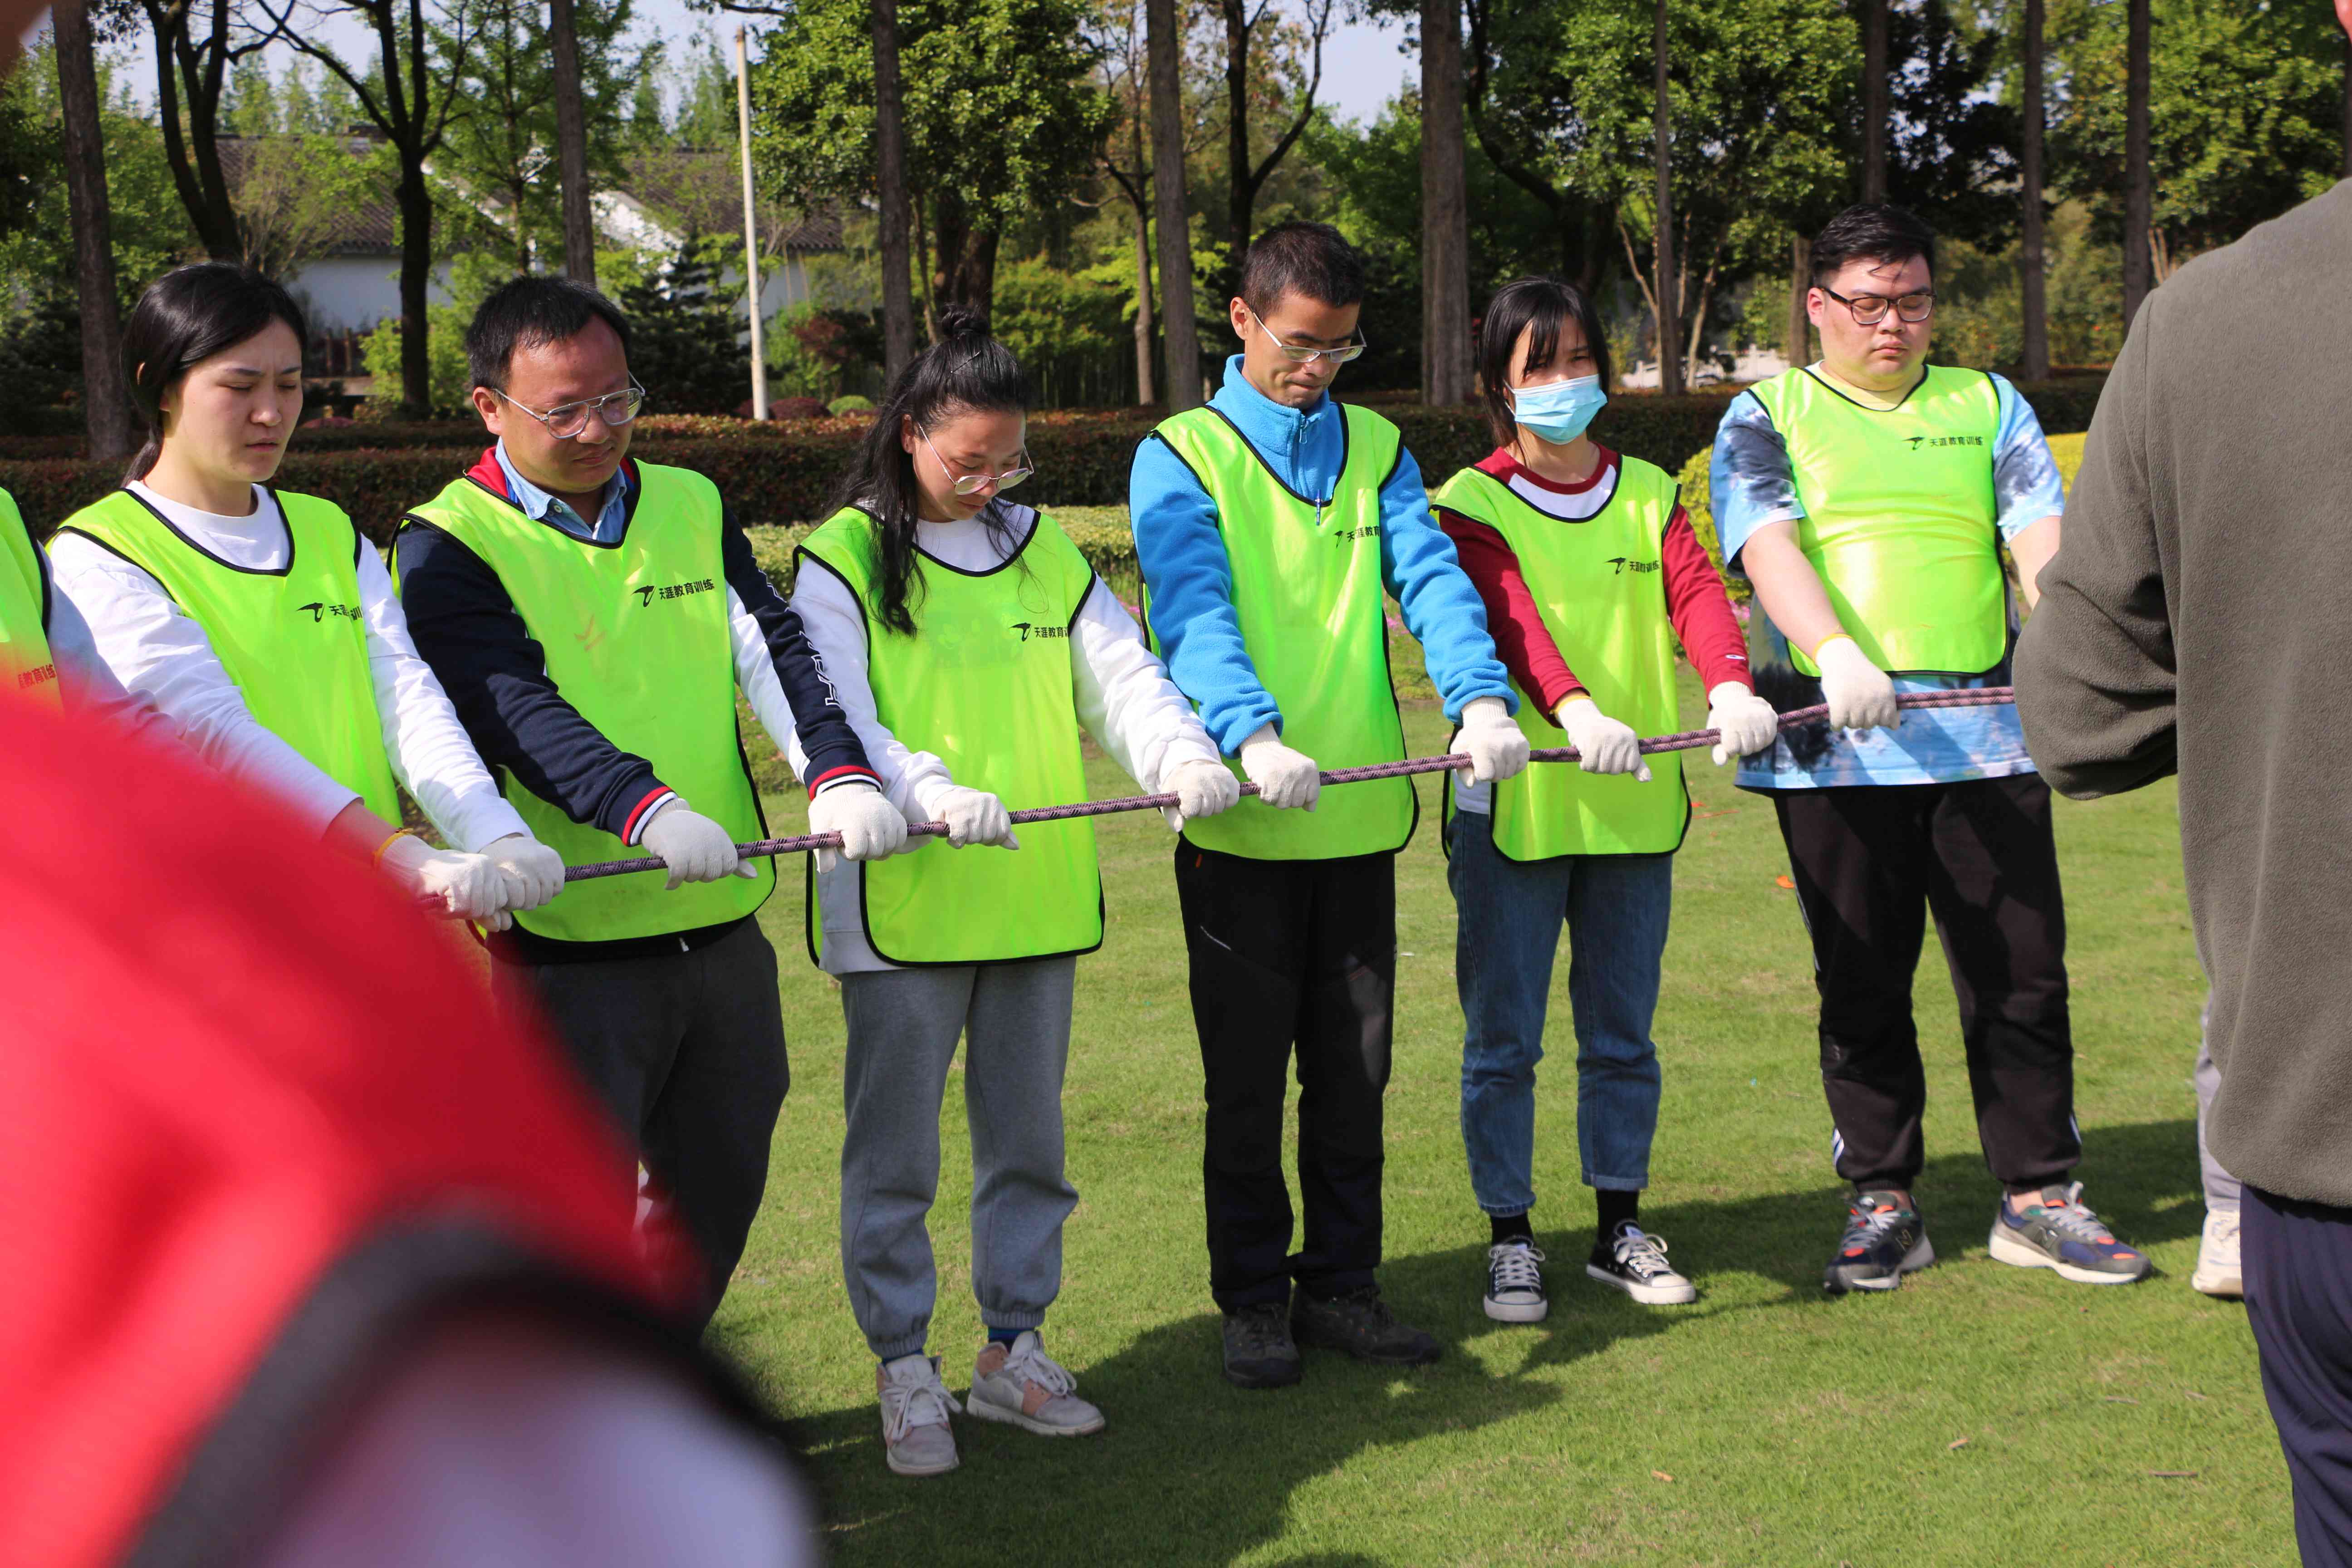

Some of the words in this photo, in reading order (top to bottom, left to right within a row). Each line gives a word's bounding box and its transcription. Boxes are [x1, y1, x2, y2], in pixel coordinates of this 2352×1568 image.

[1930, 436, 1983, 447] 天涯教育训练
[659, 578, 715, 600] 天涯教育训练
